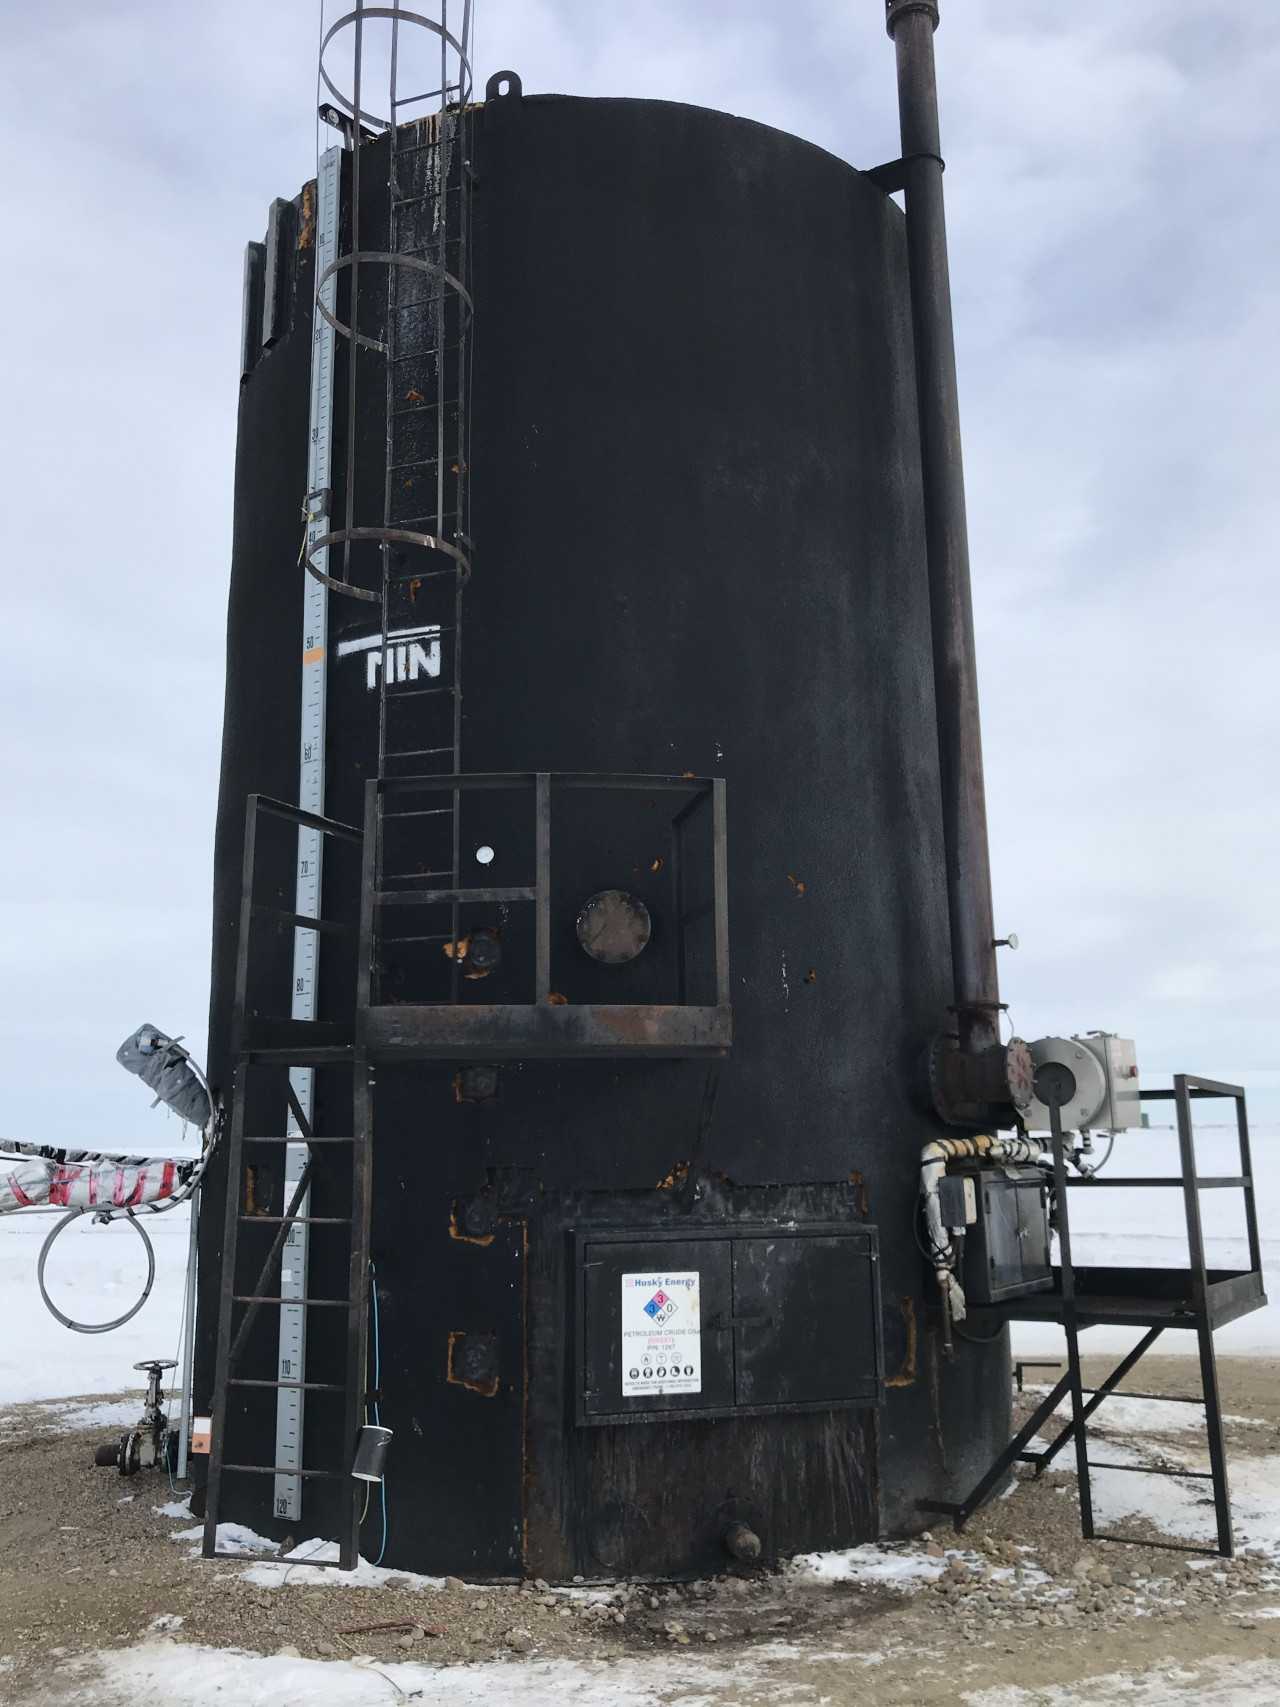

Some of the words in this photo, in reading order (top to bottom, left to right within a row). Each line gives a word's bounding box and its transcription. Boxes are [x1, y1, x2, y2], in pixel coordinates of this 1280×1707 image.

[306, 636, 314, 649] 50
[304, 744, 312, 760] 60
[301, 861, 309, 875] 70
[296, 978, 304, 992] 80
[634, 1278, 664, 1288] Husky
[665, 1276, 696, 1288] Energy
[658, 1293, 664, 1304] 3
[649, 1304, 656, 1314] 3
[667, 1303, 673, 1313] 0
[657, 1314, 665, 1322] W
[624, 1329, 663, 1338] PETROLEUM
[663, 1328, 686, 1337] CRUDE
[281, 1360, 291, 1375] 110
[276, 1498, 287, 1514] 120
